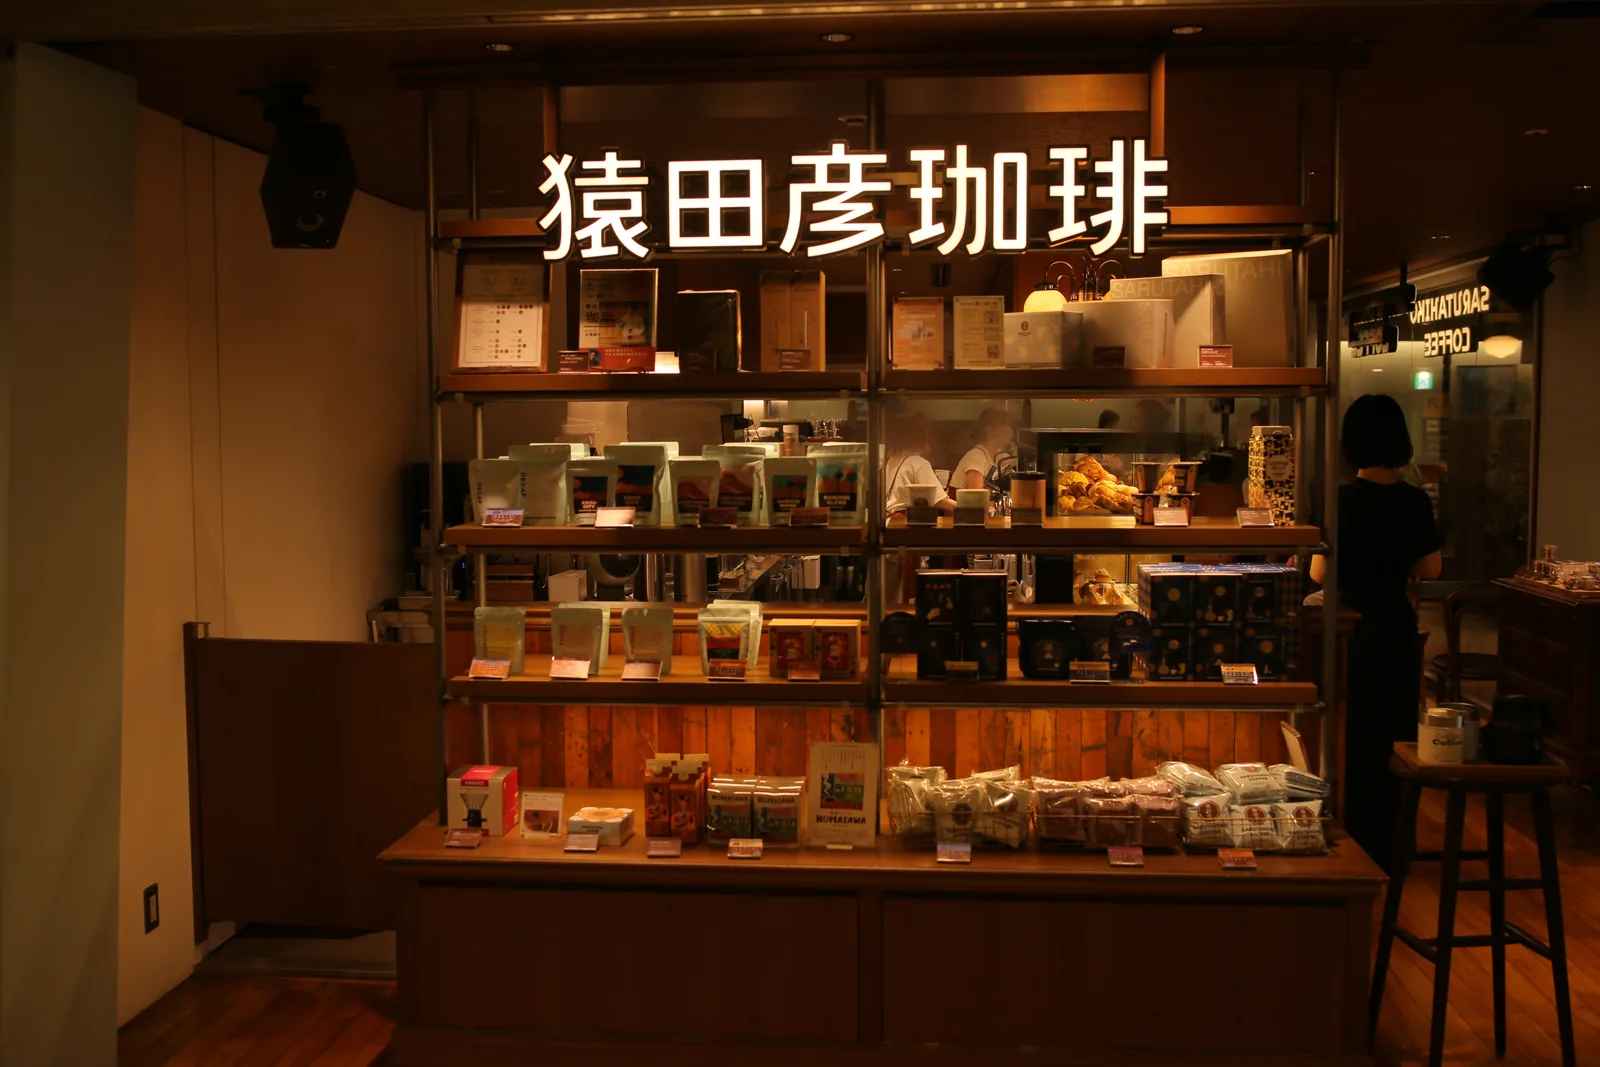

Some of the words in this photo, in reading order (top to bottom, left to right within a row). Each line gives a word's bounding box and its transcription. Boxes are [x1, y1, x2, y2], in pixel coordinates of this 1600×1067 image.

[536, 138, 1169, 262] 猿田彦珈琲
[815, 814, 867, 824] KOMAZAWA
